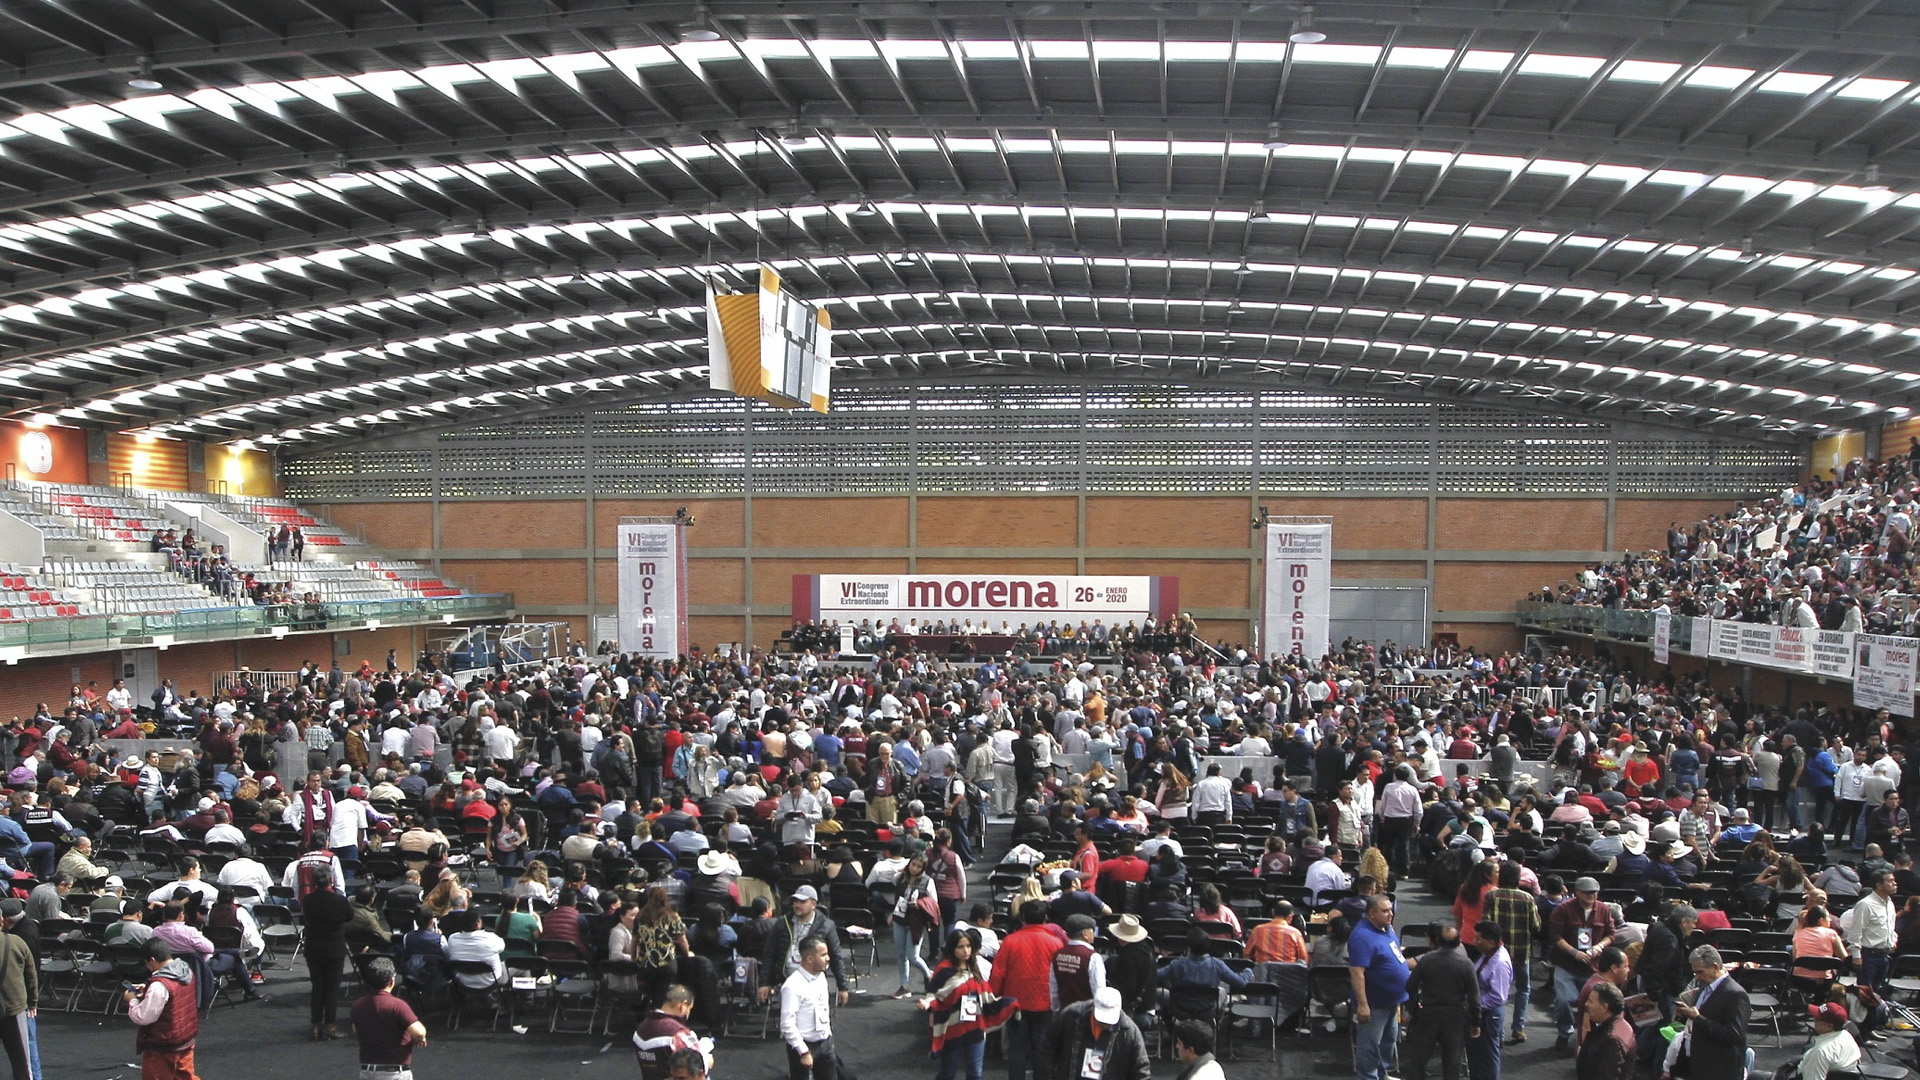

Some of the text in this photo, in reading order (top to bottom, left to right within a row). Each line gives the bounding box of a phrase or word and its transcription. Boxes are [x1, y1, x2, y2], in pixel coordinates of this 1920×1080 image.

[628, 533, 640, 546] VI
[1278, 533, 1293, 546] VI
[841, 582, 889, 597] VI Congreso
[908, 580, 1058, 608] morena
[1075, 587, 1094, 602] 26
[639, 562, 656, 649] morena
[840, 597, 889, 605] Extraordinario
[1106, 594, 1127, 603] 2020
[1289, 563, 1308, 655] morena
